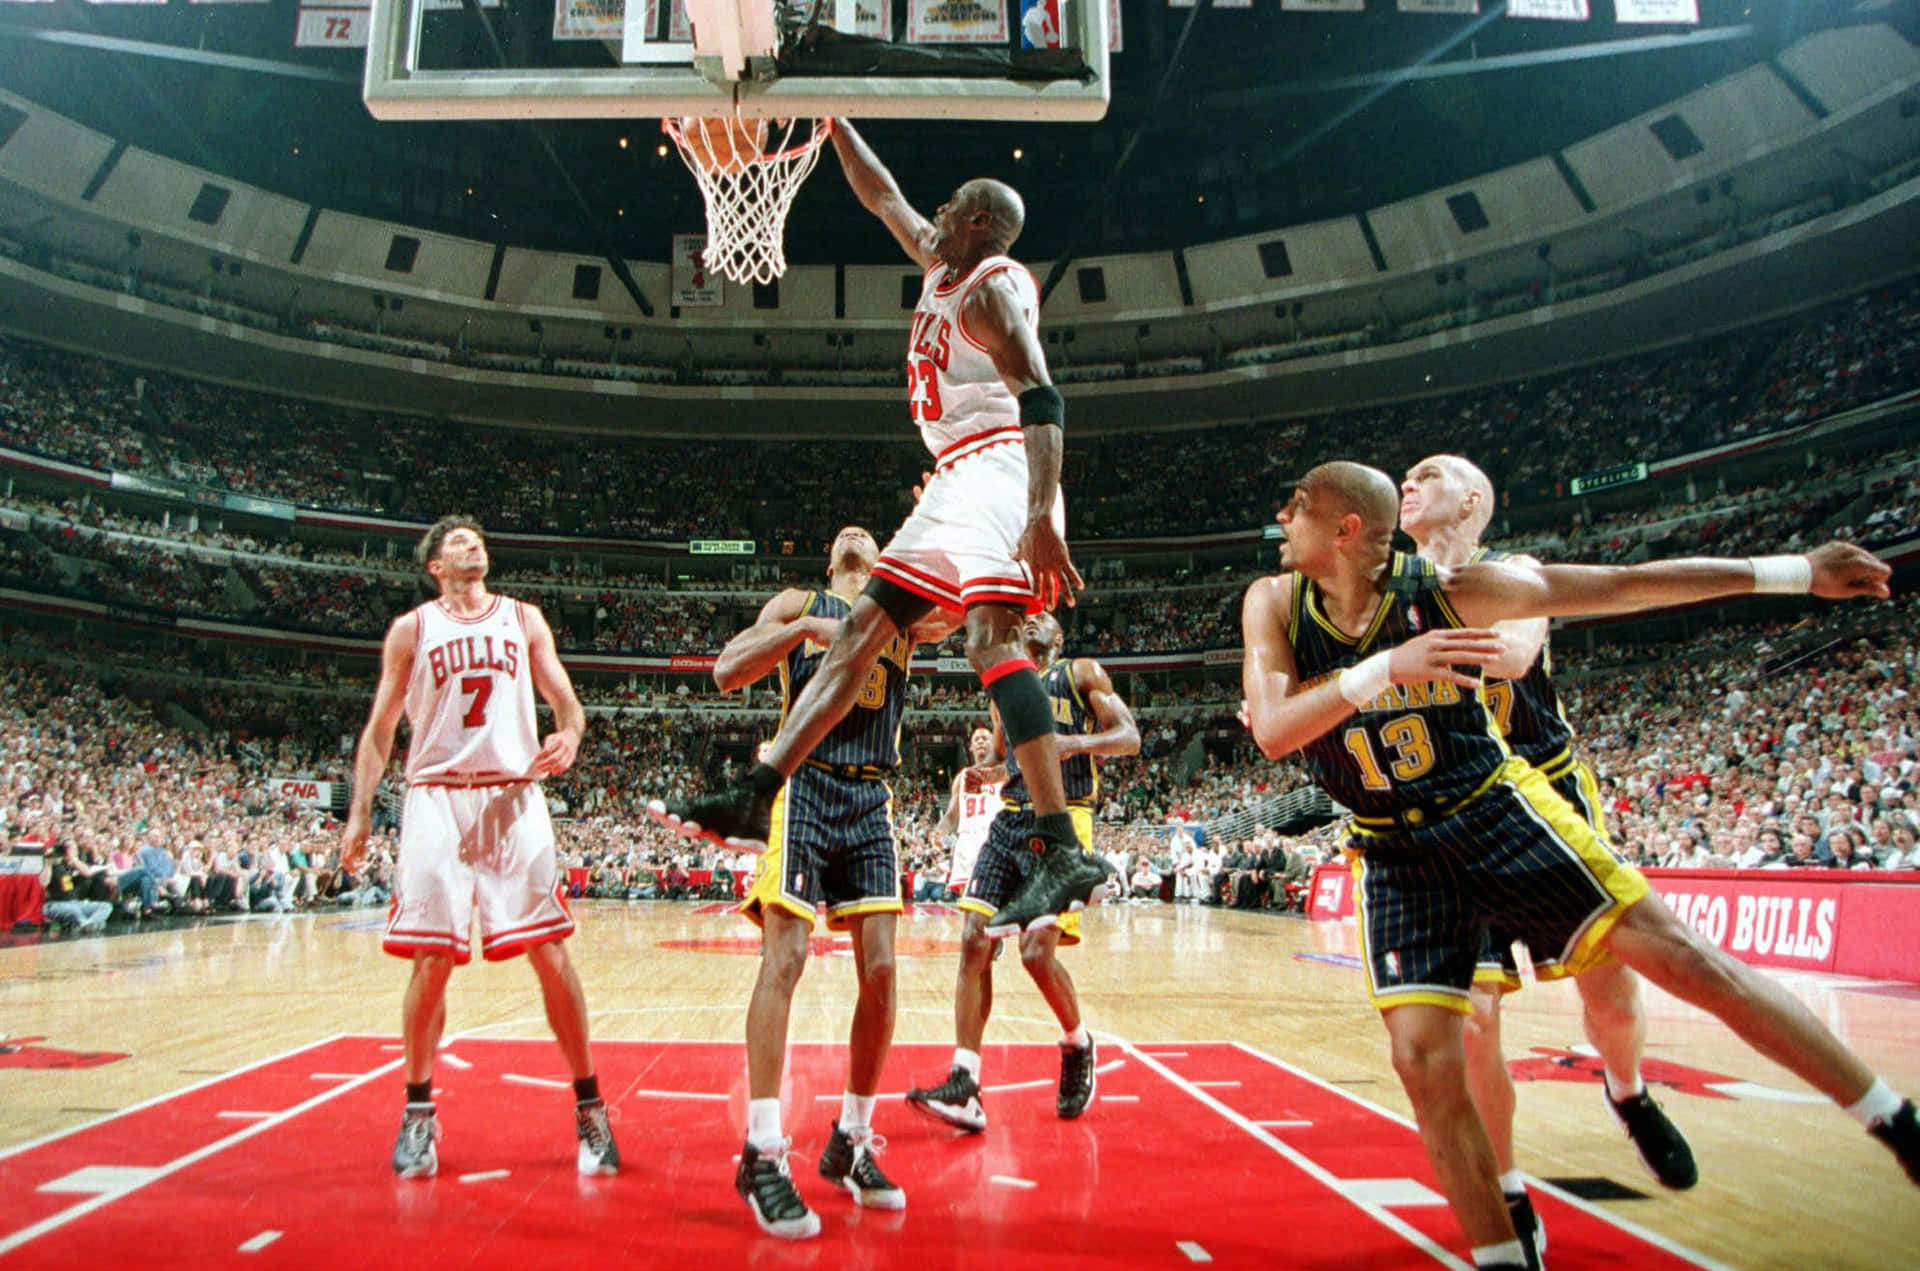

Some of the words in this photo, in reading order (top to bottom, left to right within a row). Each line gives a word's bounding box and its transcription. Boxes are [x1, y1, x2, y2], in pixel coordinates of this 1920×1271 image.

[325, 18, 351, 39] 72
[923, 12, 998, 24] CHAMPIONS
[428, 636, 518, 690] BULLS
[461, 675, 493, 728] 7
[1344, 713, 1435, 790] 13
[281, 782, 319, 799] CNA
[1732, 895, 1836, 961] BULLS
